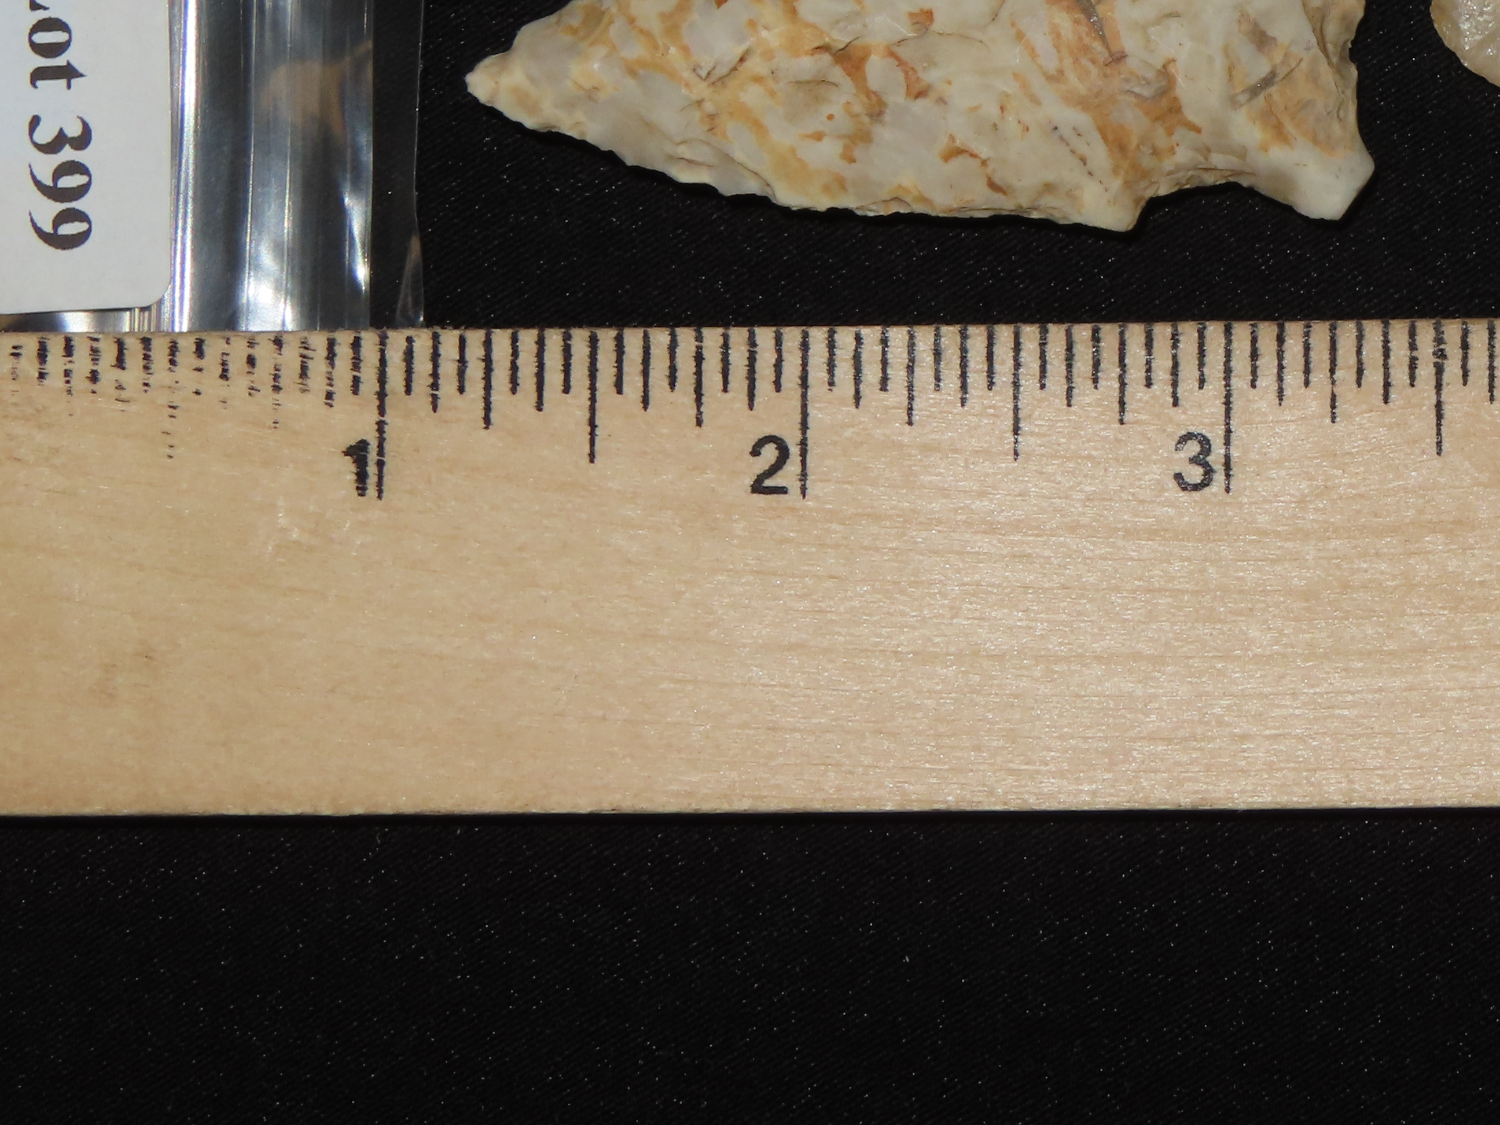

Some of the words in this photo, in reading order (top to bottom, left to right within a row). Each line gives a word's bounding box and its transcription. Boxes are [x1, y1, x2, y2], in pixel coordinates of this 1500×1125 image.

[28, 113, 92, 252] 399
[341, 438, 371, 498] 1
[748, 434, 791, 496] 2
[1173, 431, 1217, 492] 3
